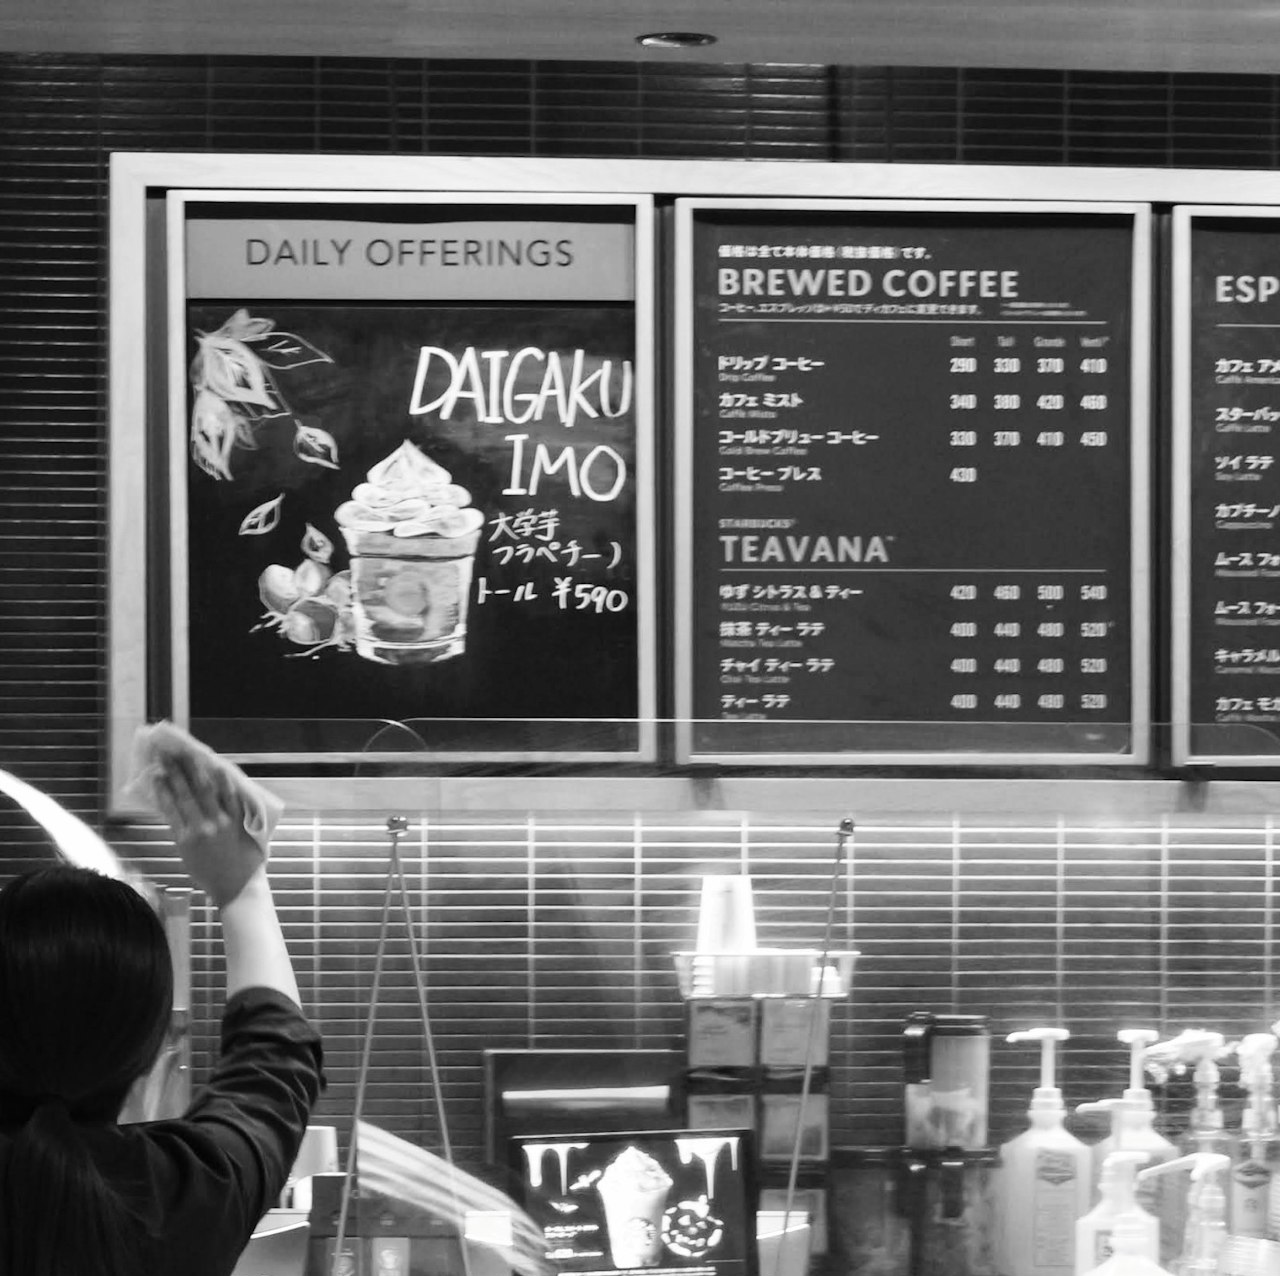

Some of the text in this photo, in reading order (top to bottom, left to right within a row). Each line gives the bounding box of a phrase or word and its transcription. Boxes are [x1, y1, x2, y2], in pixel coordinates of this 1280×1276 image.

[247, 239, 573, 267] DAILY OFFERINGS
[718, 268, 1019, 299] BREWED COFFEE
[772, 357, 825, 371] コーヒー
[950, 358, 976, 372] 290
[408, 345, 631, 427] DAIGAKU
[763, 393, 804, 408] ミスト
[502, 433, 626, 501] IMO
[1245, 457, 1274, 470] ラテ
[797, 622, 825, 636] ラテ
[806, 659, 835, 672] ラテ
[762, 695, 791, 708] ラテ
